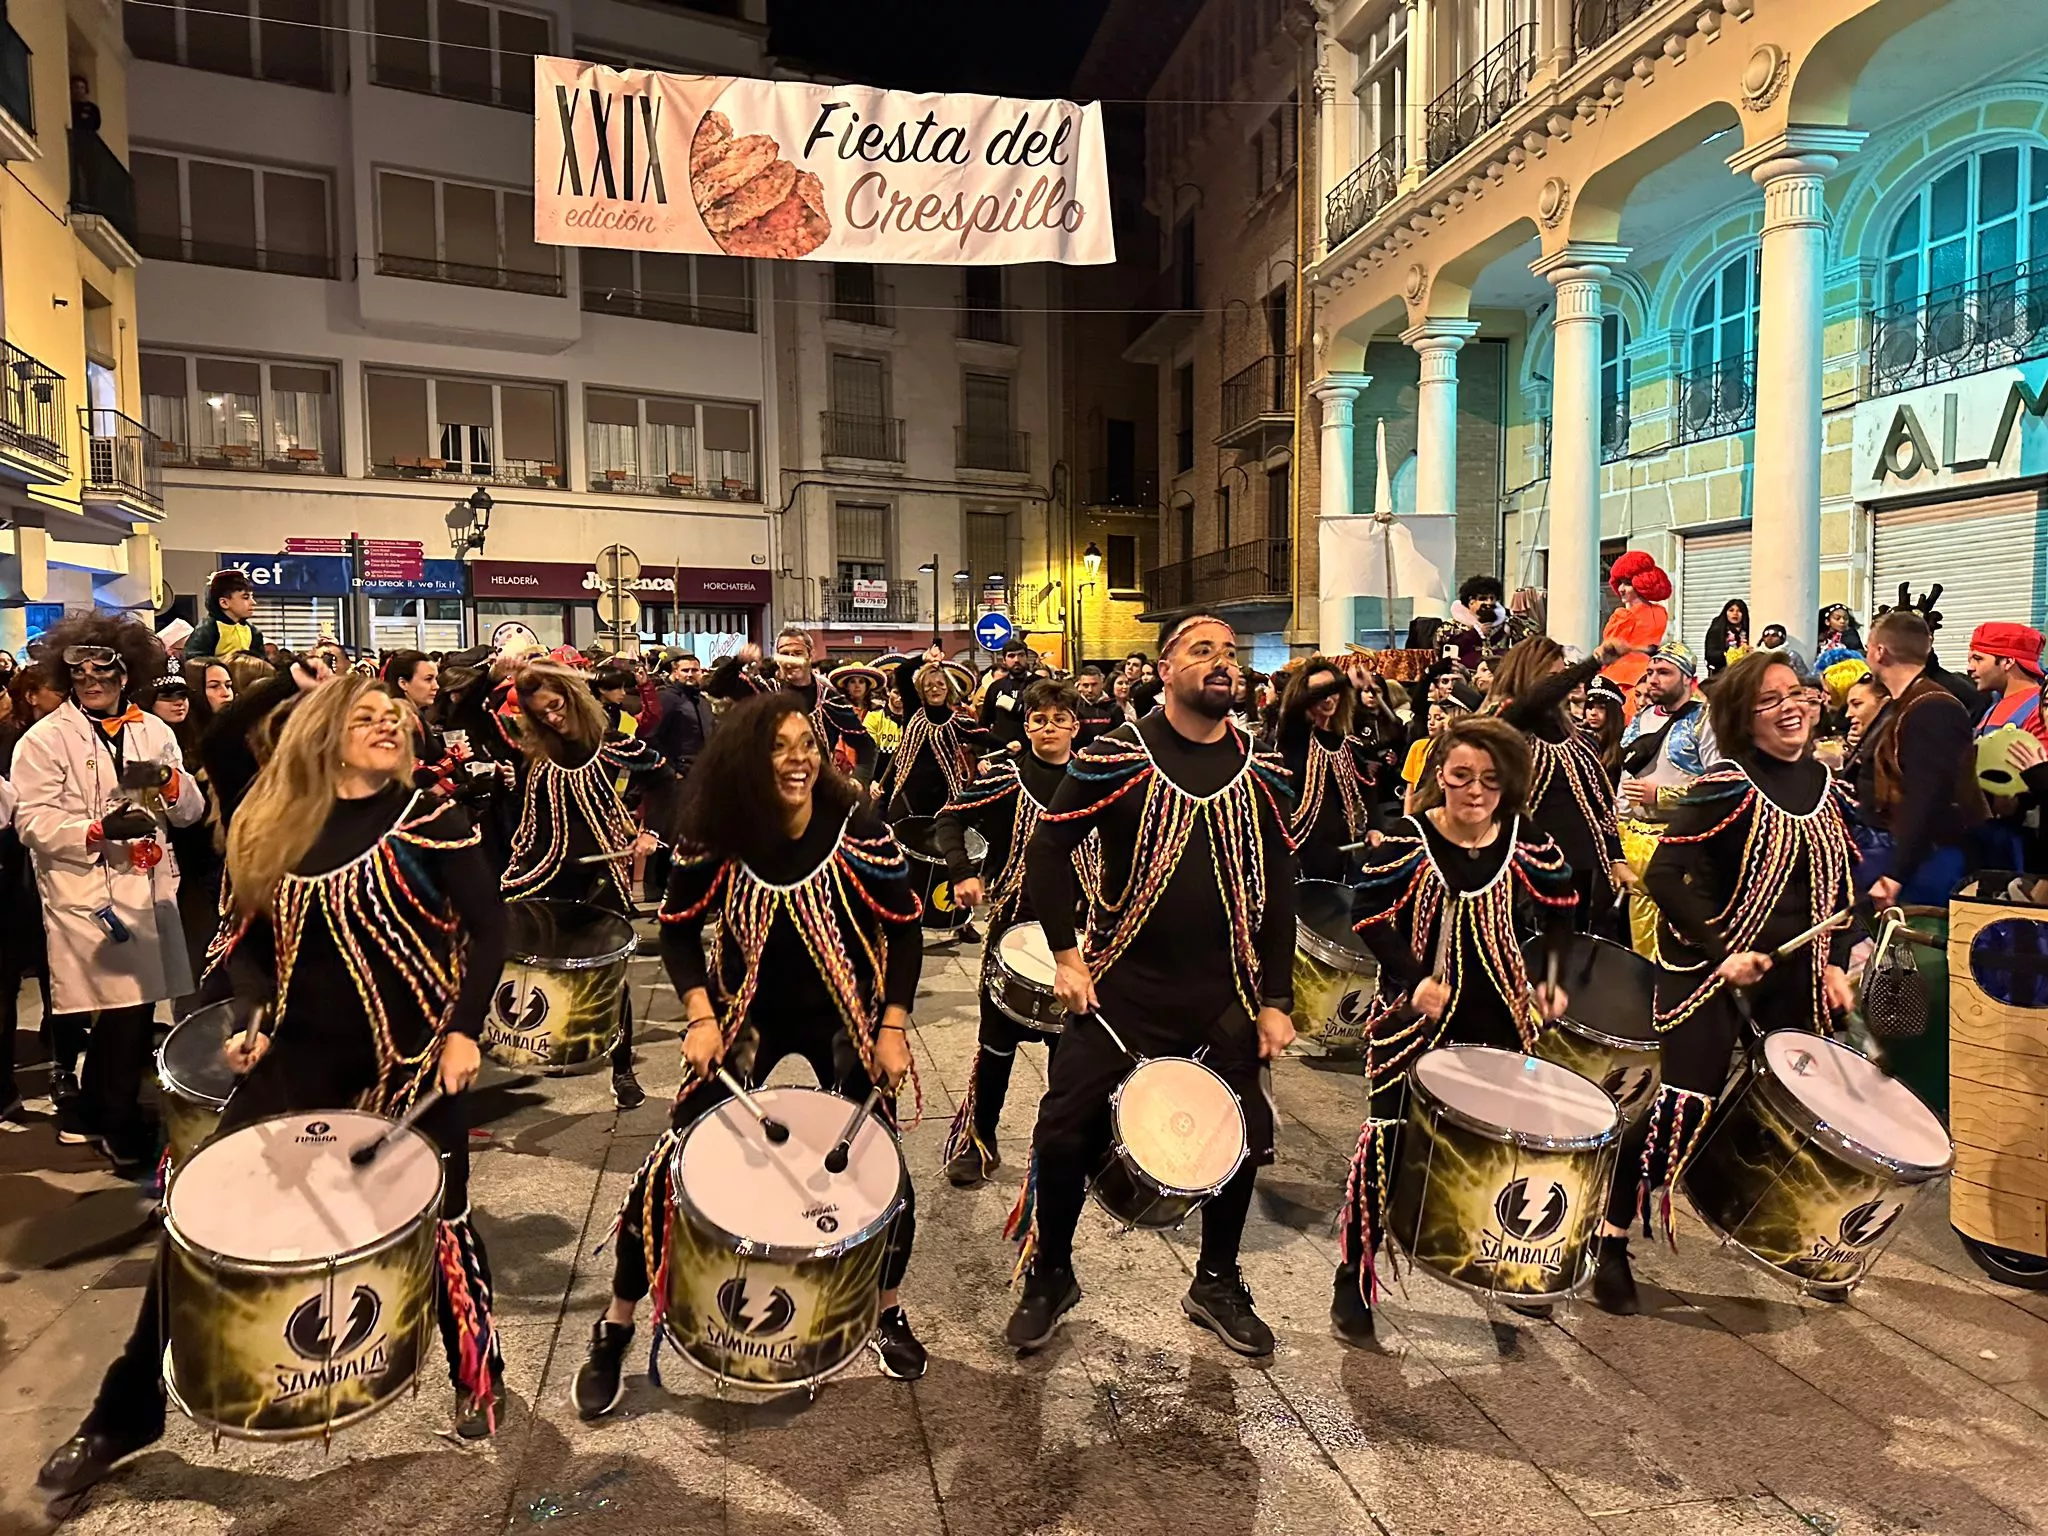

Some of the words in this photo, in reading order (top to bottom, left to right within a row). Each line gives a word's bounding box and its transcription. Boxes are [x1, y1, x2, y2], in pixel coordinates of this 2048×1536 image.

[554, 84, 668, 204] XXIX
[803, 101, 970, 164] Fiesta
[985, 112, 1073, 167] del
[564, 206, 659, 235] edición
[844, 170, 1086, 250] Crespillo
[361, 580, 377, 588] You
[379, 580, 405, 588] break
[436, 580, 447, 588] fix
[491, 574, 539, 585] HELADERÍA
[703, 581, 756, 591] HORCHATERÍA
